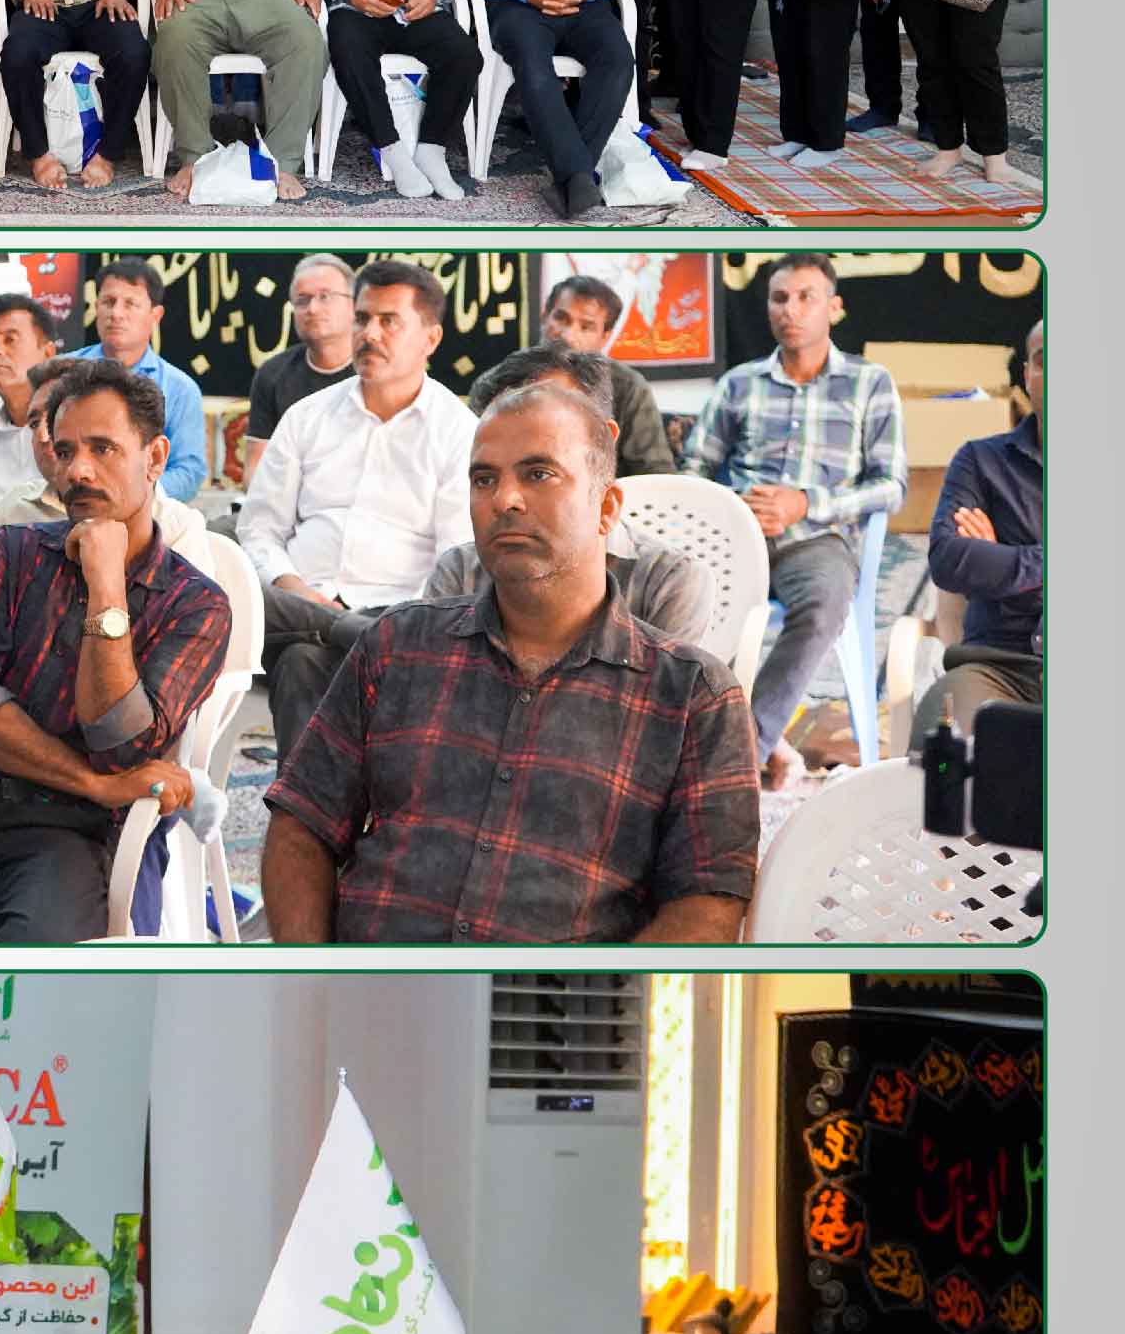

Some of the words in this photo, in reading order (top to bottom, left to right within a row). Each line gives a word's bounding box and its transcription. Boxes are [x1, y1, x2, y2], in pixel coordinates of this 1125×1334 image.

[62, 1277, 95, 1299] این
[16, 1308, 26, 1327] از
[31, 1308, 85, 1324] حفاظت
